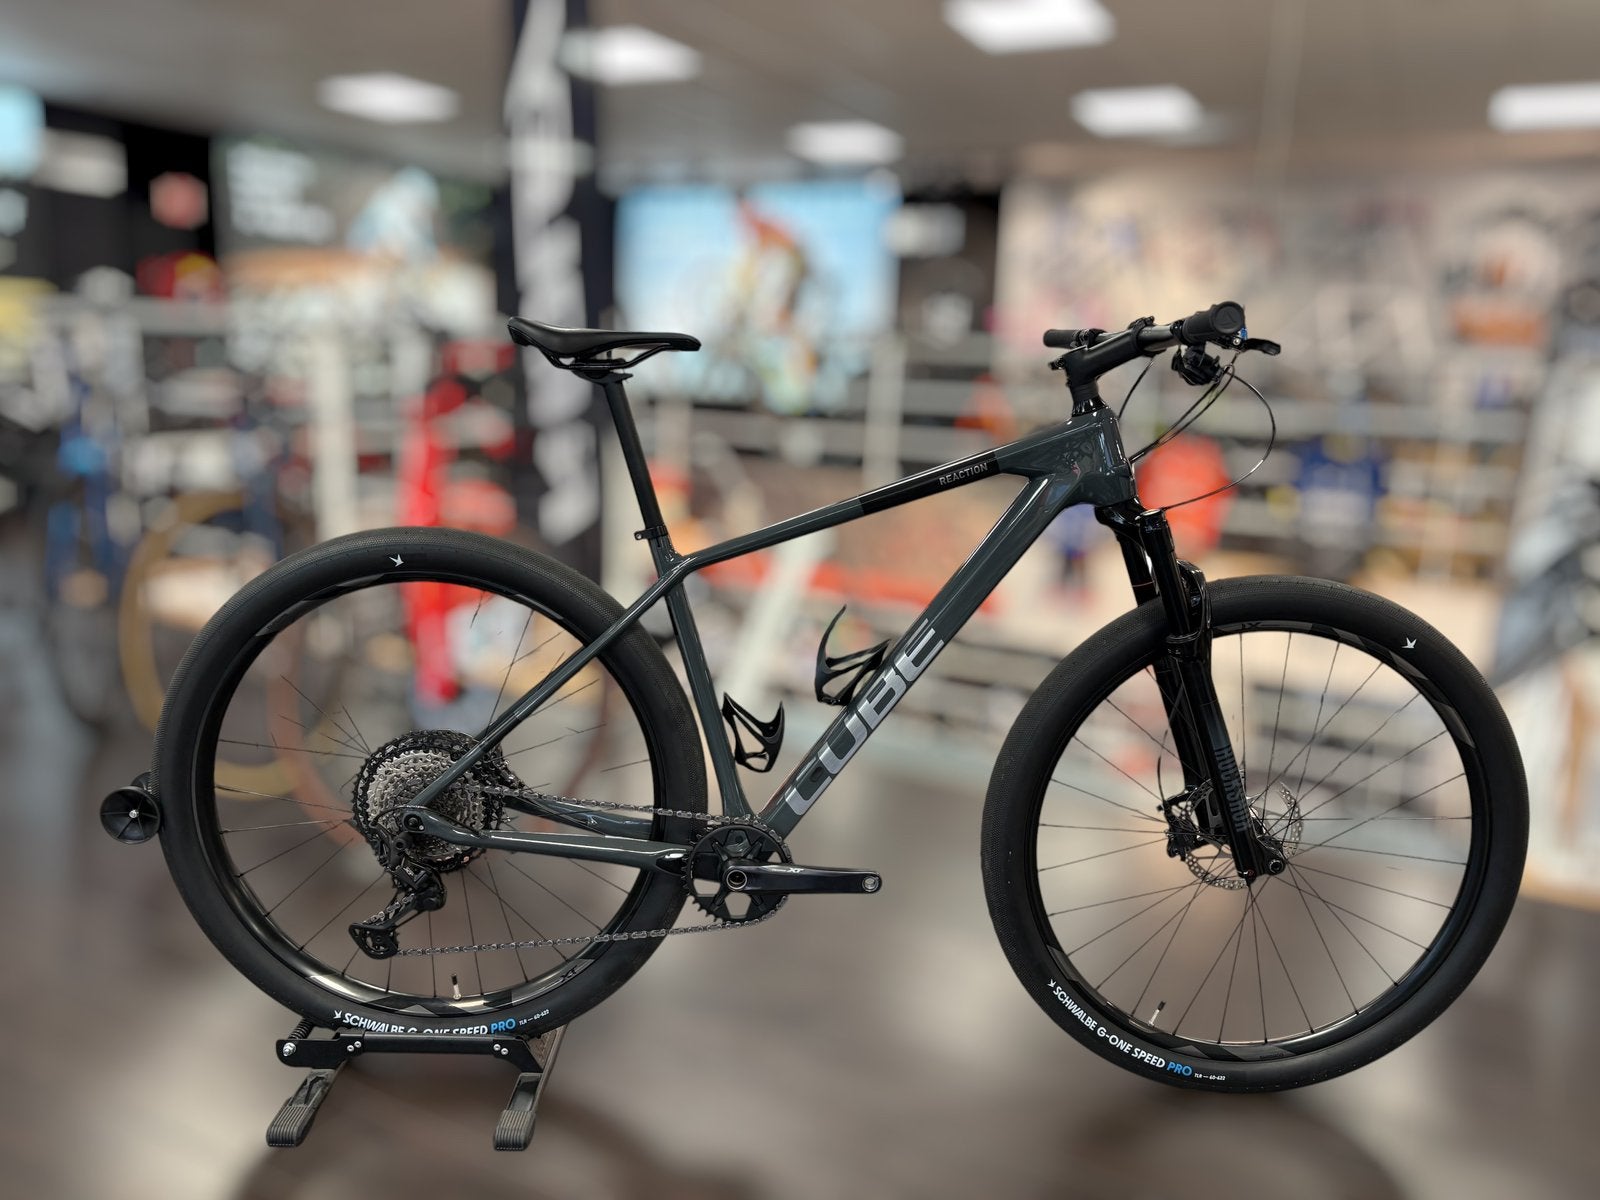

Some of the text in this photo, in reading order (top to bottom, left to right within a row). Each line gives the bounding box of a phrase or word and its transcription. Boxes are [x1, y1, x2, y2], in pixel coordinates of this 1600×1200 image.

[939, 462, 988, 486] REACTION
[784, 617, 945, 816] CUBE
[342, 1012, 405, 1033] SCHWALBE
[491, 1018, 516, 1034] PRO
[1053, 986, 1098, 1031] SCHWALBE
[1096, 1026, 1133, 1054] G-ONE
[1131, 1047, 1166, 1068] SPEED
[1166, 1061, 1193, 1076] PRO
